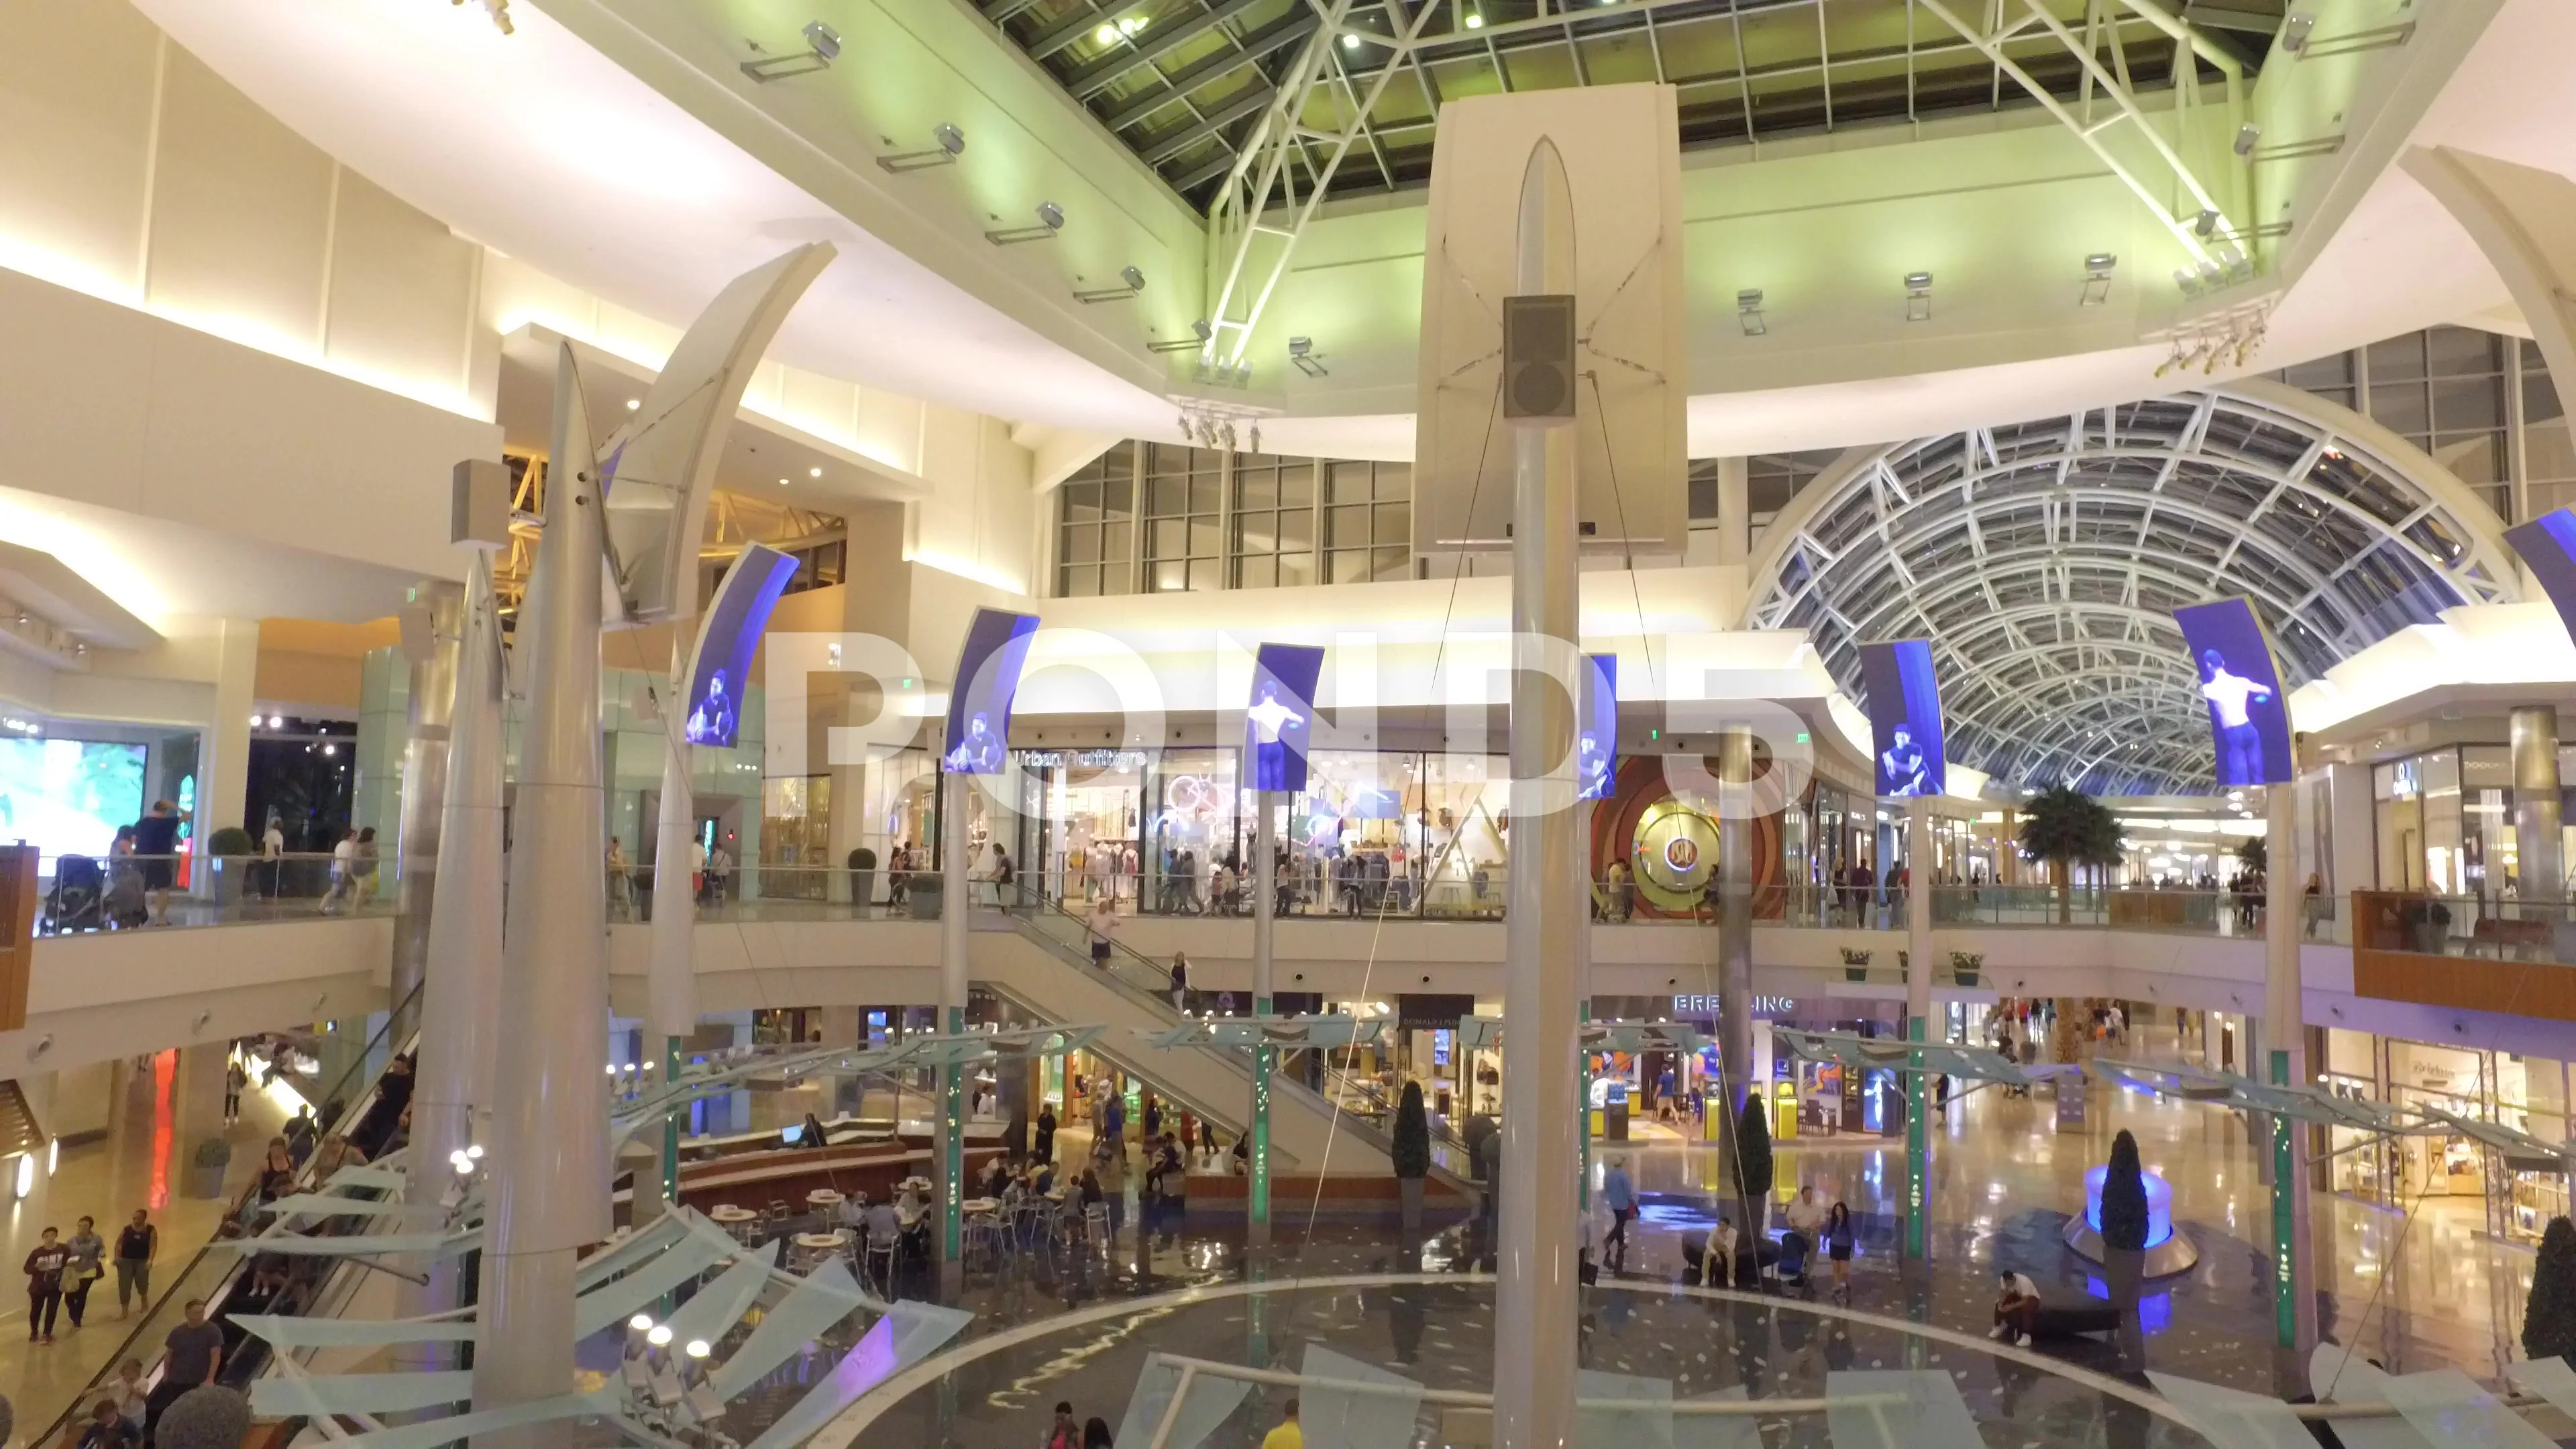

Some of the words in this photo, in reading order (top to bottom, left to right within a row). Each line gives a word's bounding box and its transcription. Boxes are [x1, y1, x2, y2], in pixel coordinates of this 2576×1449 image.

[1014, 749, 1062, 767] Urban
[1066, 749, 1147, 767] Outfitters
[1674, 994, 1794, 1012] BREING
[1403, 1018, 1438, 1026] DONALD
